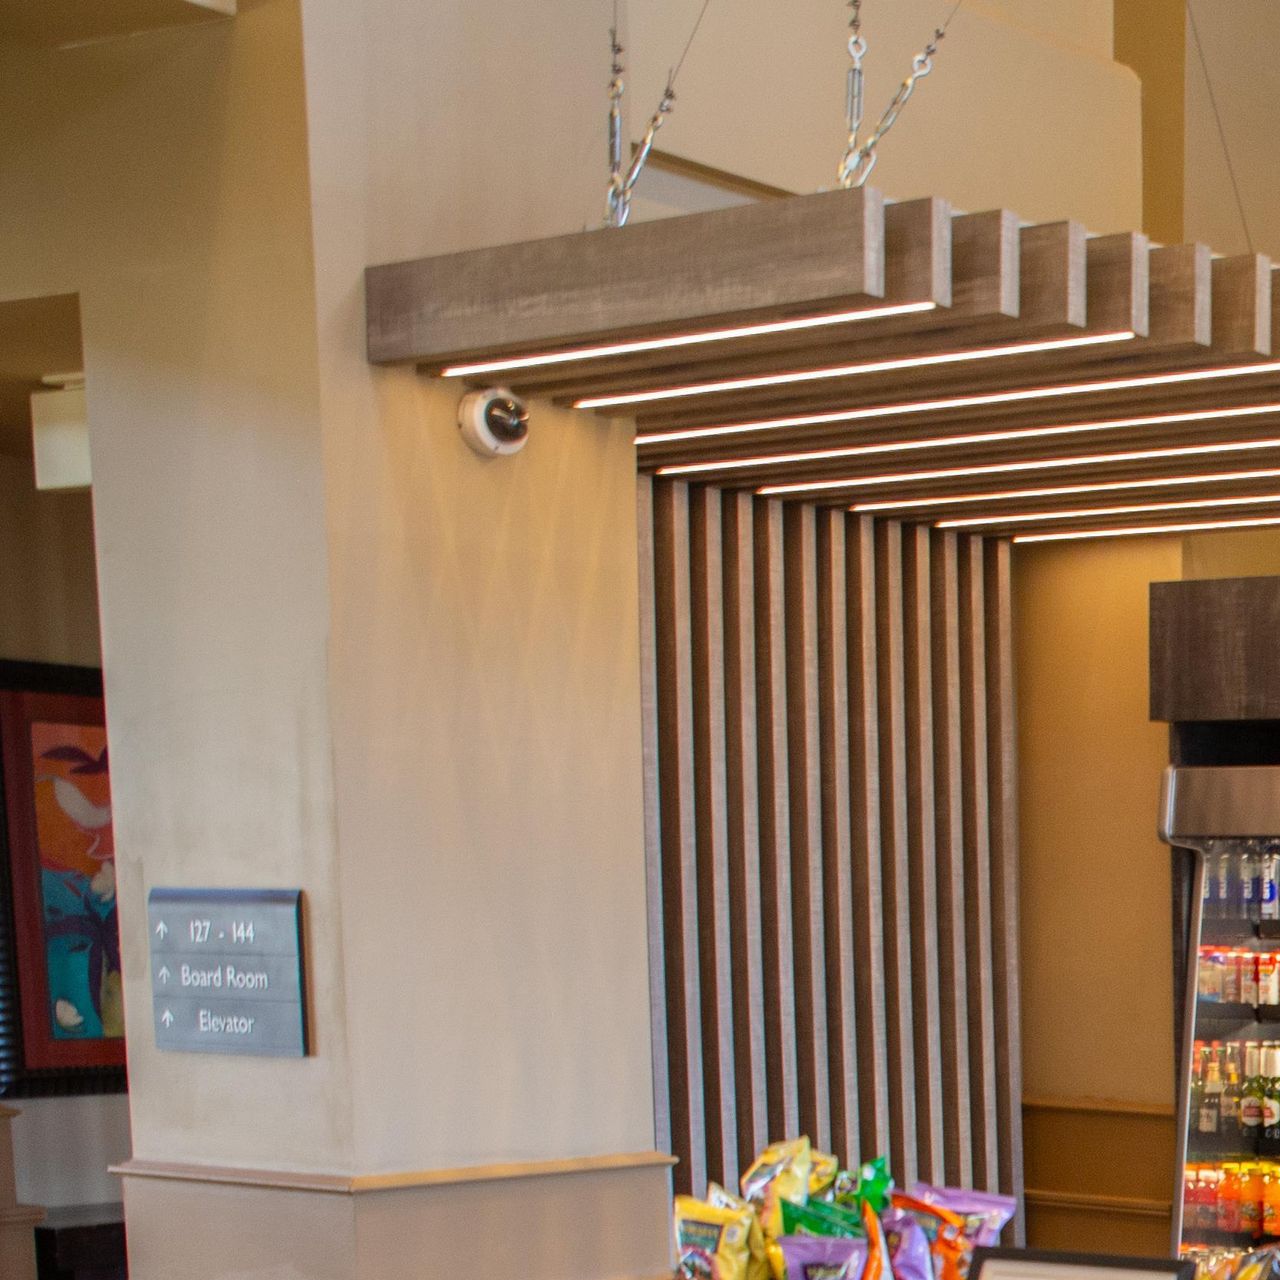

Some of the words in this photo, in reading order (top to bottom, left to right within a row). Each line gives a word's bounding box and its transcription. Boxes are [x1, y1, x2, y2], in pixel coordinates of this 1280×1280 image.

[189, 920, 211, 944] 127
[232, 920, 256, 944] 144
[180, 965, 222, 988] Board
[226, 967, 268, 990] Room
[199, 1010, 255, 1034] Elevator
